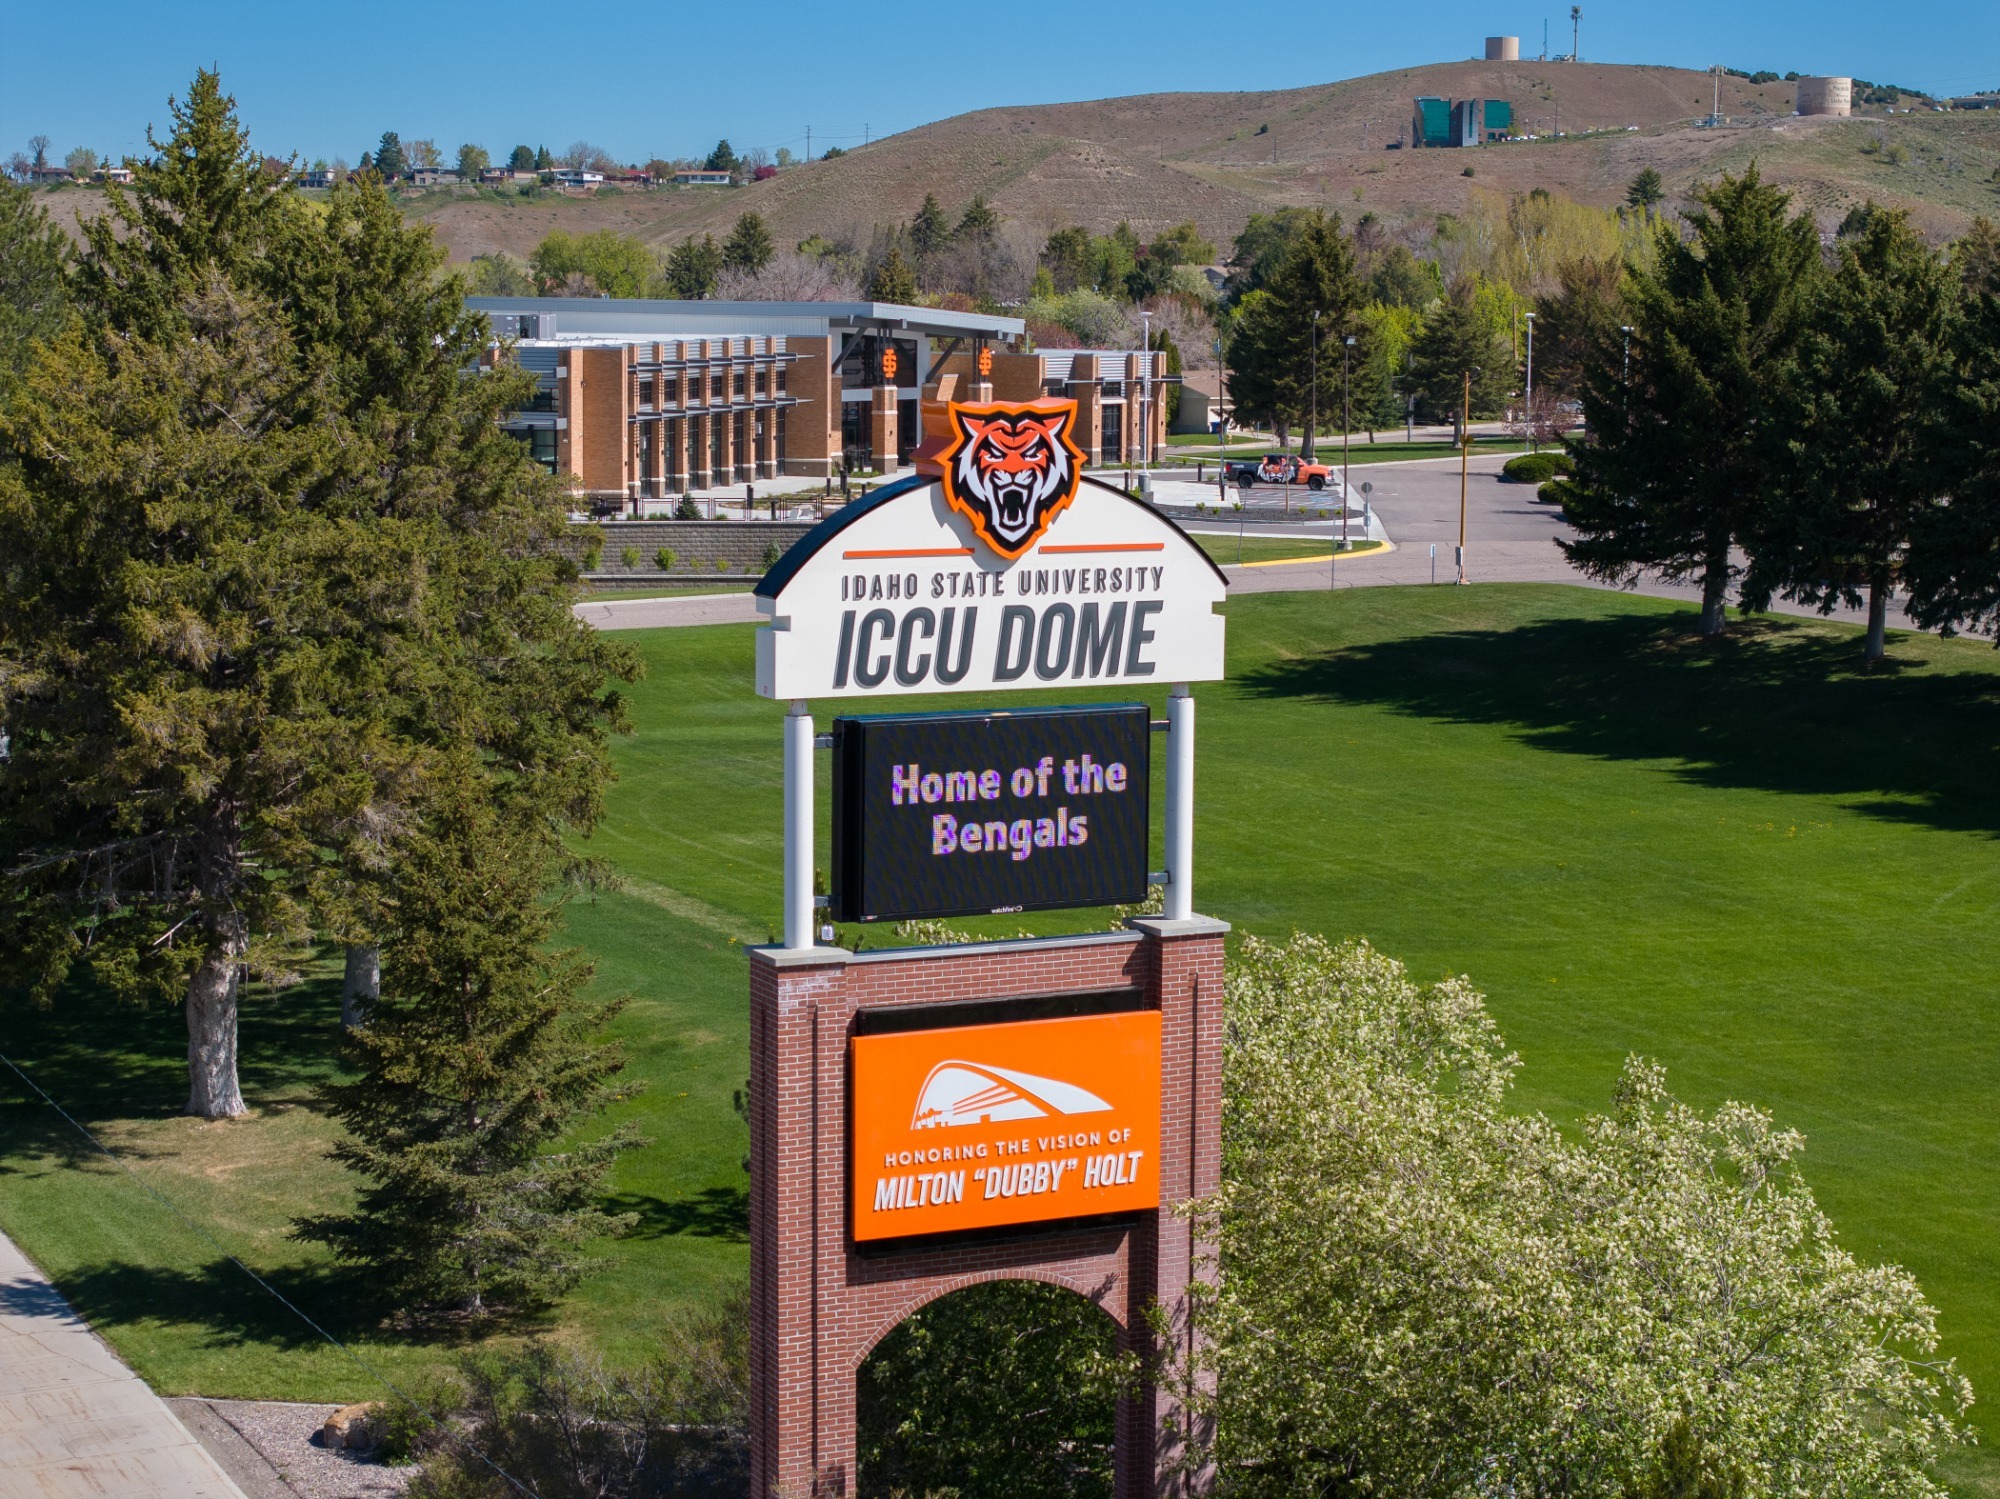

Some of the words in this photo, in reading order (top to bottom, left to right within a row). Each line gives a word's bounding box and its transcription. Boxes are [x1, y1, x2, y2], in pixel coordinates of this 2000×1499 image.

[841, 573, 919, 601] IDAHO
[930, 570, 1006, 598] STATE
[1018, 566, 1165, 595] UNIVERSITY
[832, 606, 979, 689] ICCU
[992, 600, 1165, 682] DOME
[892, 764, 1002, 806] Home
[1010, 756, 1053, 798] of
[1062, 754, 1128, 795] the
[932, 807, 1088, 861] Bengals
[884, 1143, 988, 1167] HONORING
[995, 1139, 1030, 1154] THE
[1037, 1132, 1101, 1151] VISION
[1108, 1128, 1132, 1143] OF
[873, 1170, 965, 1211] MILTON
[1083, 1151, 1144, 1188] HOLT
